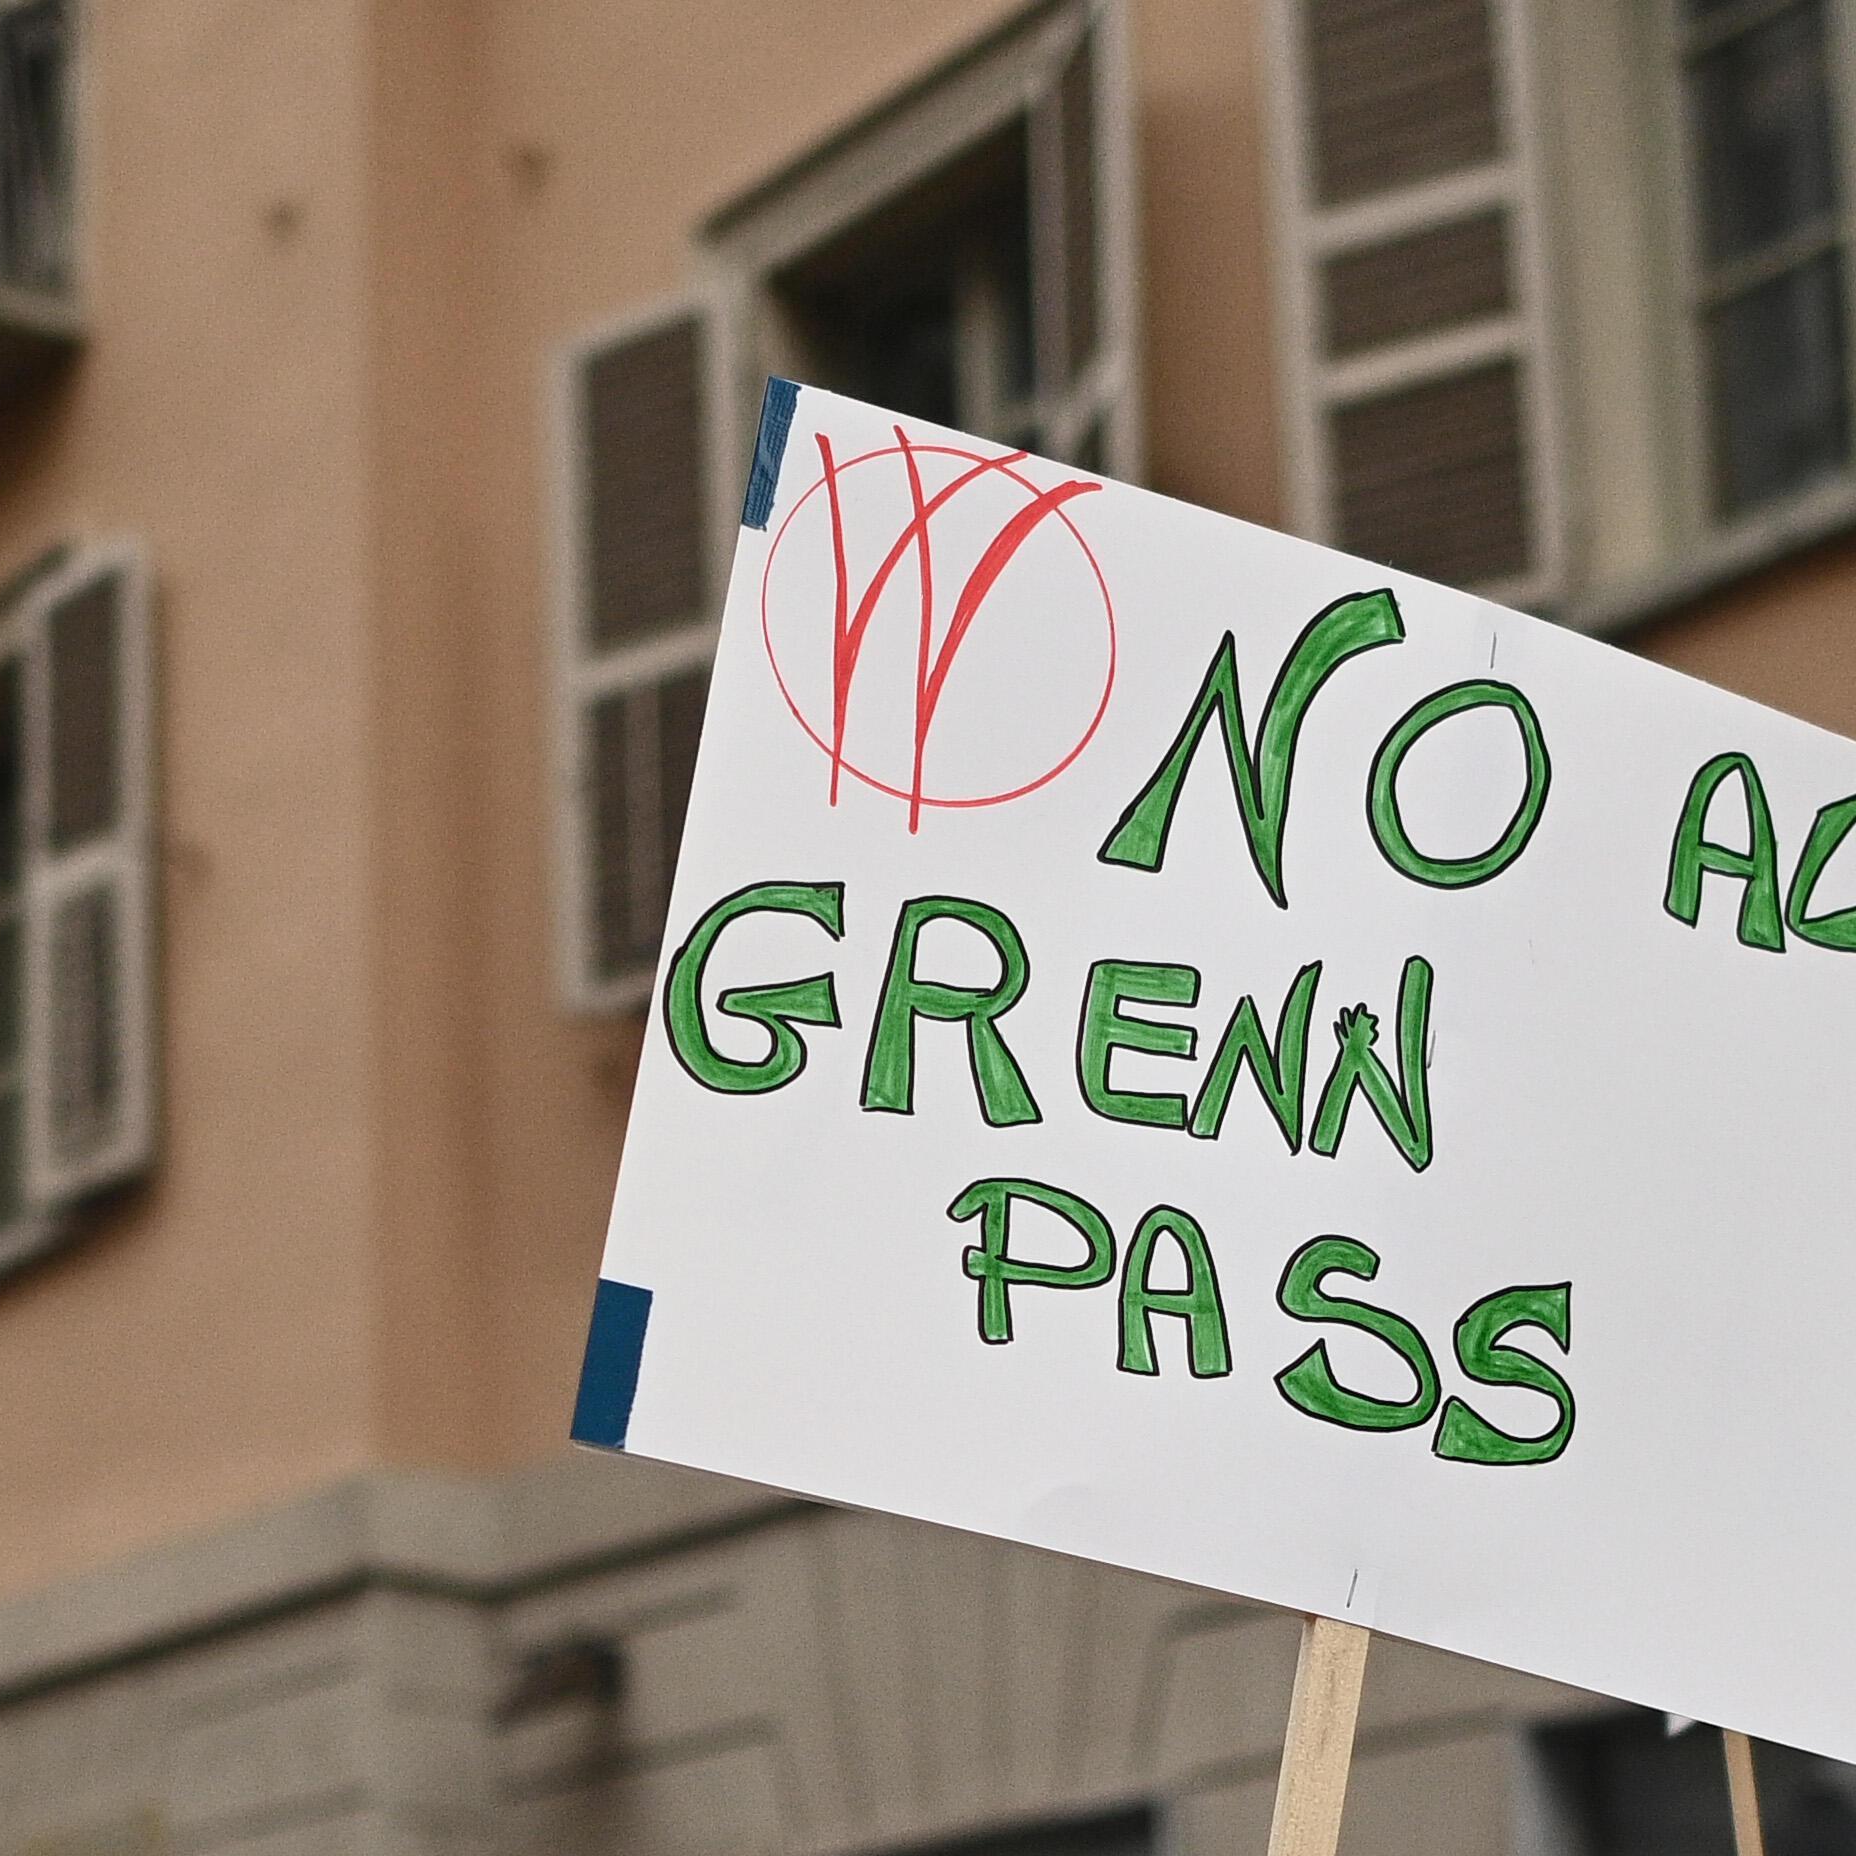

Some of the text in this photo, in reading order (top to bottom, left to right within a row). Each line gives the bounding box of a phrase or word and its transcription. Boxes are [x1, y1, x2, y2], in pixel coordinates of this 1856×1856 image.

[1097, 587, 1551, 908] NO
[662, 881, 1435, 1172] GRENN
[945, 1176, 1577, 1466] PASS
